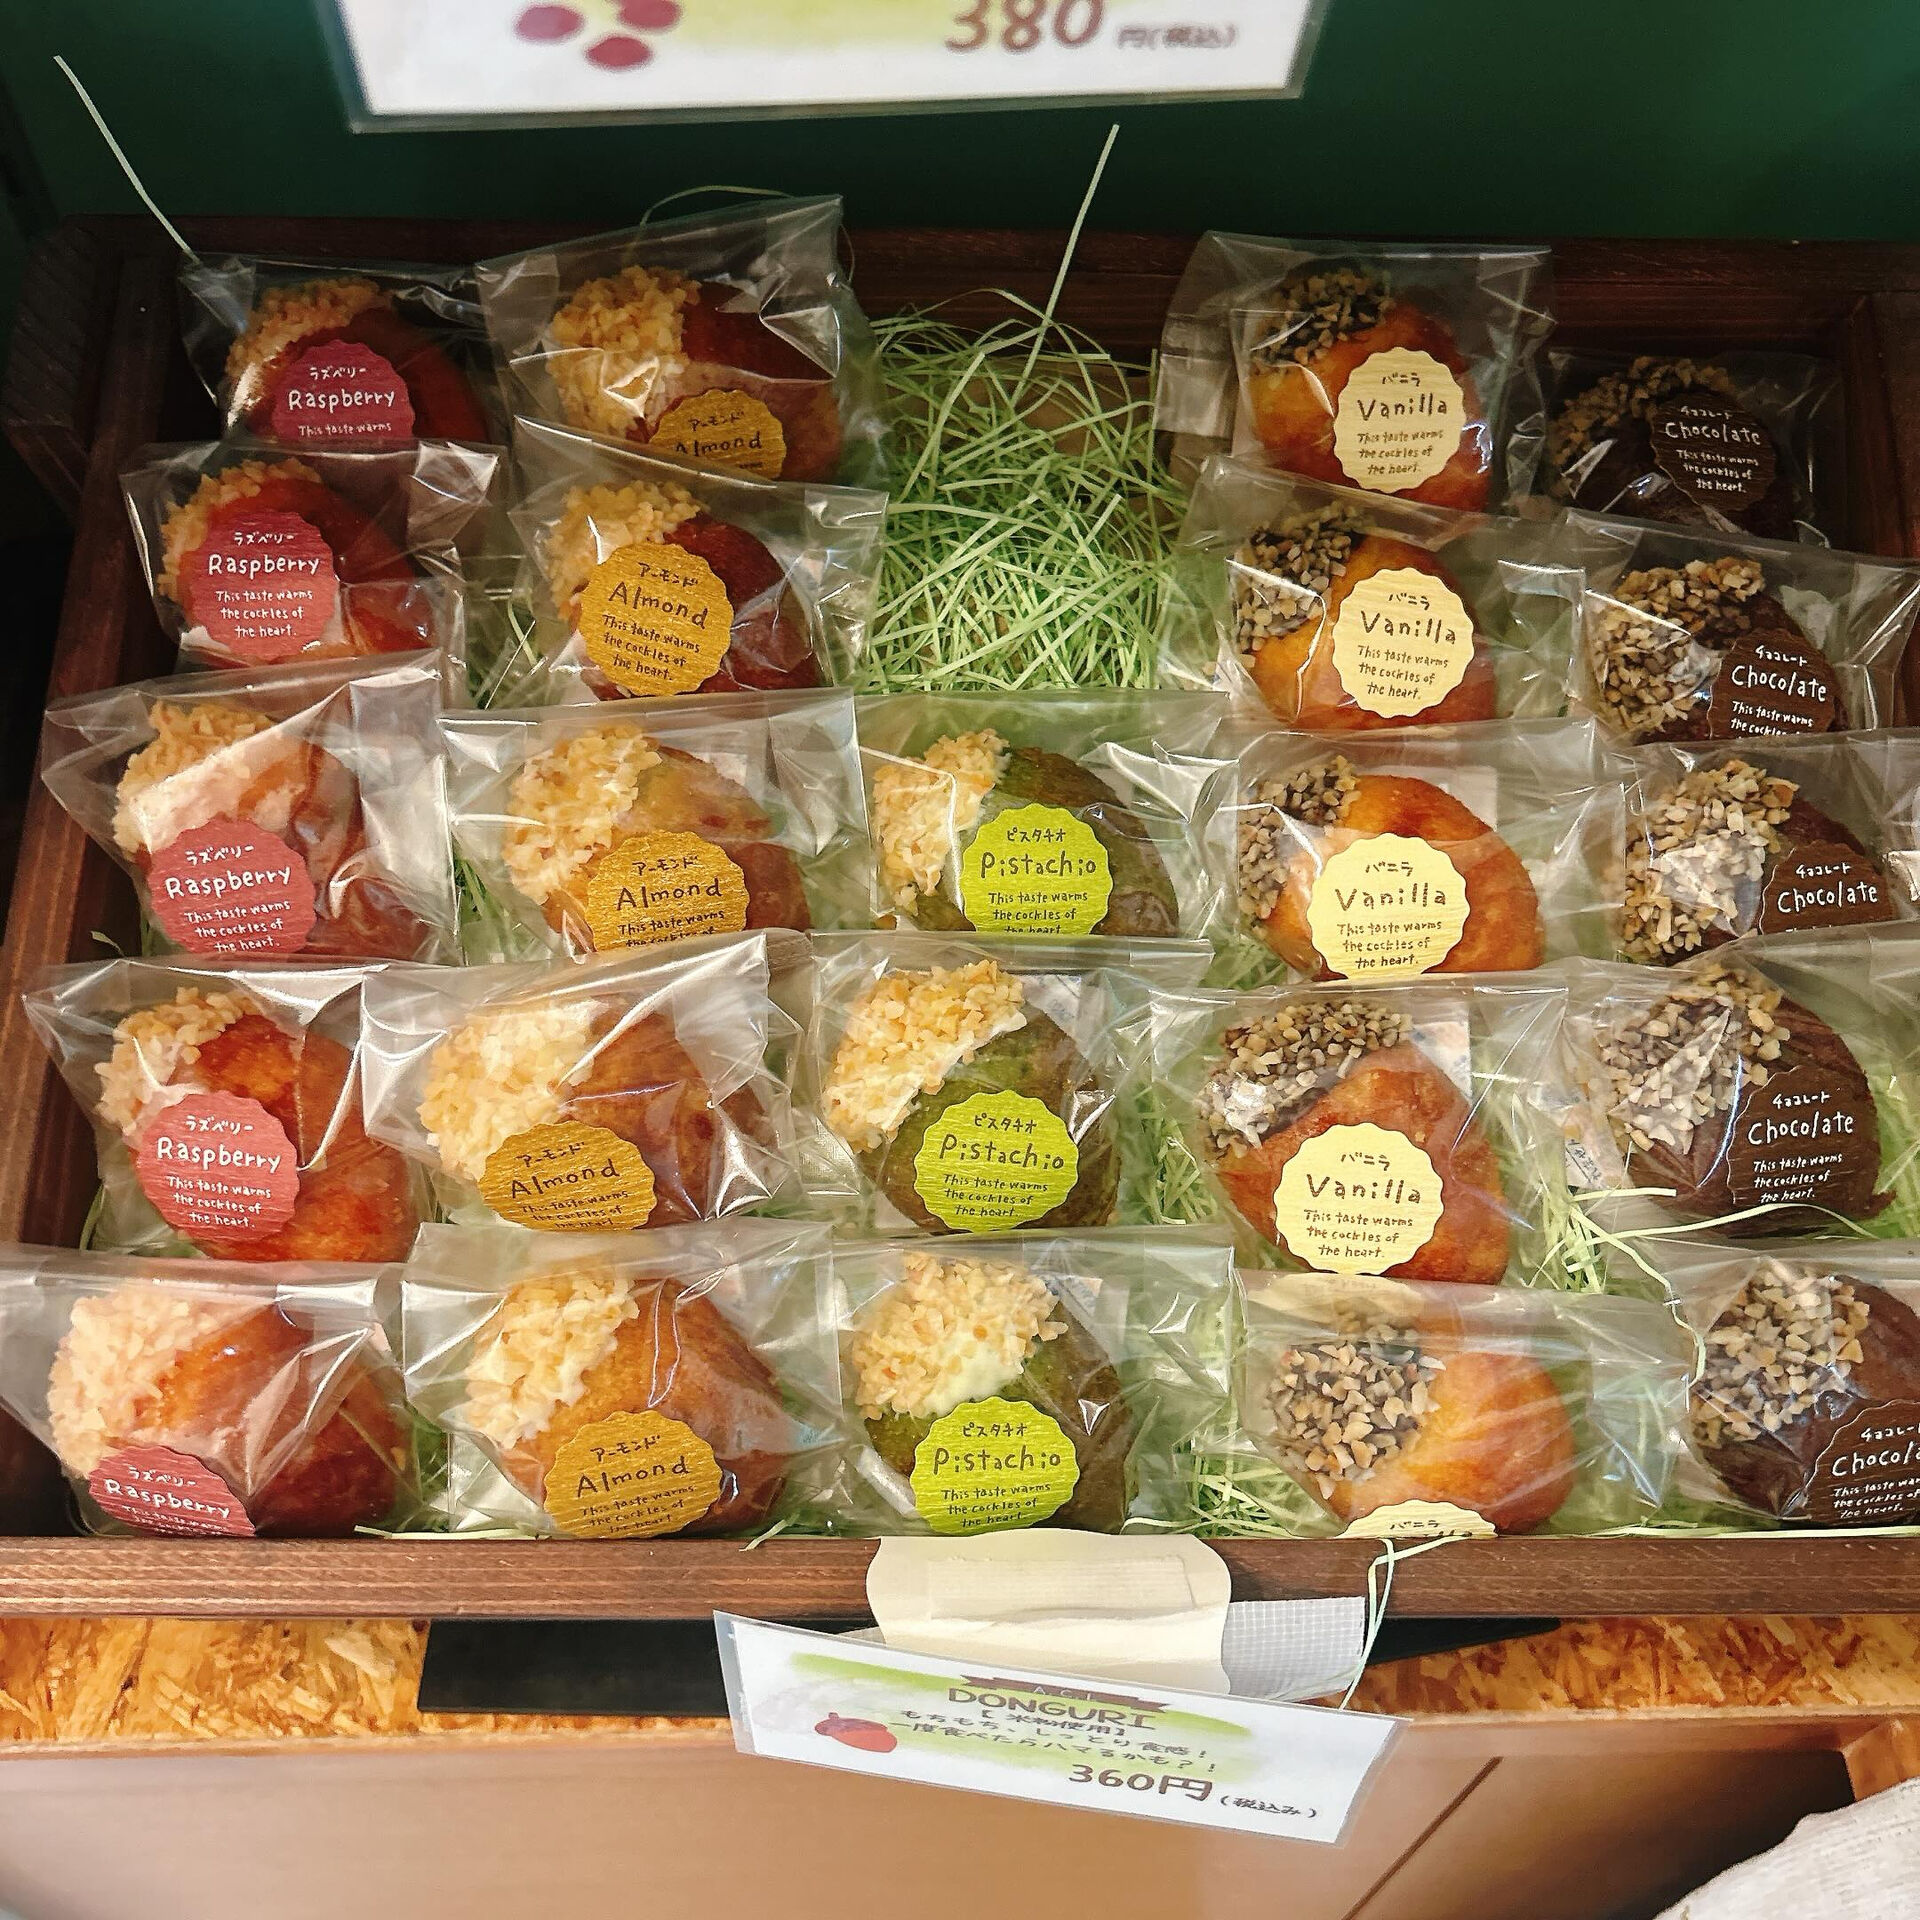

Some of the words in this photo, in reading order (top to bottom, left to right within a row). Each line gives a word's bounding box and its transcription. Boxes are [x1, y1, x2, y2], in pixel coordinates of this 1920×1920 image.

[310, 365, 366, 380] ラズベリー
[1382, 372, 1420, 386] バニラ
[288, 388, 394, 413] Raspberry
[1357, 393, 1447, 421] Vanilla
[298, 425, 322, 436] This
[326, 424, 354, 435] taste
[356, 422, 392, 433] warms
[1666, 422, 1761, 445] Chocolate
[676, 431, 762, 456] Almond
[234, 531, 294, 546] ラズベリー
[209, 554, 319, 580] Raspberry
[638, 562, 698, 587] アーモンド
[216, 591, 240, 602] This
[243, 590, 272, 602] taste
[277, 590, 313, 600] warms
[608, 581, 708, 630] Almond
[1388, 592, 1430, 611] バニラ
[220, 607, 240, 619] the
[243, 608, 288, 619] cockles
[292, 606, 303, 619] of
[235, 626, 255, 638] the
[259, 624, 297, 637] heart.
[602, 614, 627, 630] This
[630, 623, 660, 641] taste
[664, 635, 700, 653] warms
[1361, 610, 1456, 644] Vanilla
[604, 632, 622, 648] the
[625, 642, 669, 663] cockles
[673, 656, 686, 667] of
[1358, 645, 1381, 658] This
[1384, 649, 1412, 664] taste
[1415, 655, 1449, 668] warms
[1755, 645, 1807, 666] チョコレート
[613, 654, 631, 669] the
[636, 661, 672, 681] heart.
[1359, 662, 1377, 675] the
[1379, 668, 1420, 683] cockles
[1423, 673, 1435, 685] of
[1367, 682, 1385, 695] the
[1388, 685, 1421, 700] heart.
[1731, 665, 1826, 701] Chocolate
[1732, 701, 1753, 714] This
[1756, 706, 1780, 721] taste
[1783, 713, 1813, 727] warms
[1731, 718, 1747, 731] the
[1007, 827, 1066, 842] ピスタチオ
[185, 845, 254, 866] ラズベリー
[981, 850, 1096, 879] Pistachio
[633, 856, 698, 876] アーモンド
[1365, 861, 1414, 877] バニラ
[1795, 862, 1852, 879] チョコレート
[165, 867, 291, 899] Raspberry
[617, 877, 722, 910] Almond
[988, 892, 1014, 905] This
[1018, 891, 1048, 904] taste
[1052, 892, 1088, 901] warms
[1335, 882, 1446, 911] Vanilla
[1778, 881, 1878, 913] Chocolate
[184, 912, 212, 924] This
[214, 906, 247, 921] taste
[250, 901, 290, 915] warms
[618, 924, 646, 935] This
[650, 917, 682, 931] taste
[685, 910, 724, 924] warms
[994, 909, 1012, 920] the
[1016, 909, 1060, 921] cockles
[1065, 908, 1077, 920] of
[195, 925, 216, 938] the
[220, 923, 267, 935] cockles
[270, 918, 283, 930] of
[1337, 923, 1364, 936] This
[1367, 922, 1400, 935] taste
[1404, 921, 1442, 932] warms
[214, 941, 236, 953] the
[239, 935, 280, 951] heart.
[1342, 940, 1363, 952] the
[1366, 940, 1413, 952] cockles
[1418, 937, 1431, 949] of
[1355, 956, 1375, 969] the
[1380, 954, 1419, 967] heart.
[1772, 1091, 1831, 1109] チョコレート
[185, 1115, 253, 1135] ラズベリー
[974, 1112, 1037, 1134] ピスタチオ
[1748, 1111, 1853, 1145] Chocolate
[157, 1137, 280, 1173] Raspberry
[515, 1141, 585, 1167] アーモンド
[939, 1134, 1064, 1169] Pistachio
[1341, 1152, 1390, 1171] バニラ
[1754, 1160, 1776, 1172] This
[1780, 1157, 1806, 1170] taste
[1810, 1154, 1843, 1165] warms
[166, 1176, 194, 1189] This
[198, 1180, 228, 1194] taste
[232, 1186, 271, 1198] warms
[511, 1158, 620, 1199] Almond
[943, 1174, 969, 1185] This
[974, 1177, 1005, 1189] taste
[1010, 1180, 1048, 1192] warms
[1306, 1173, 1421, 1204] Vanilla
[1754, 1177, 1770, 1188] the
[1774, 1174, 1814, 1187] cockles
[1818, 1170, 1830, 1181] of
[174, 1193, 194, 1206] the
[197, 1198, 244, 1212] cockles
[248, 1203, 261, 1214] of
[944, 1188, 964, 1200] the
[969, 1194, 1015, 1204] cockles
[1020, 1195, 1034, 1205] of
[1761, 1193, 1779, 1203] the
[1781, 1187, 1815, 1200] heart.
[189, 1212, 210, 1224] the
[215, 1215, 255, 1228] heart.
[955, 1205, 975, 1216] the
[1304, 1209, 1331, 1222] This
[1335, 1212, 1368, 1225] taste
[1373, 1216, 1413, 1227] warms
[1306, 1226, 1328, 1238] the
[1332, 1230, 1381, 1243] cockles
[1385, 1233, 1400, 1243] of
[1318, 1244, 1340, 1256] the
[1345, 1245, 1384, 1258] heart.
[962, 1422, 1028, 1437] ピスタチオ
[590, 1434, 661, 1462] アーモンド
[933, 1445, 1061, 1475] Pistachio
[128, 1465, 196, 1487] ラズベリー
[577, 1455, 689, 1497] Almond
[104, 1479, 230, 1519] Raspberry
[652, 1486, 694, 1500] warms
[941, 1489, 970, 1501] This
[973, 1486, 1007, 1499] taste
[1011, 1483, 1051, 1495] warms
[1834, 1487, 1859, 1497] This
[1865, 1481, 1894, 1492] taste
[948, 1504, 968, 1515] the
[972, 1502, 1020, 1513] cockles
[1025, 1498, 1037, 1508] of
[1833, 1500, 1853, 1508] the
[961, 1517, 981, 1527] the
[1390, 1520, 1441, 1529] バニラ
[949, 1687, 1156, 1730] DONGURI
[1068, 1764, 1213, 1801] 360円
